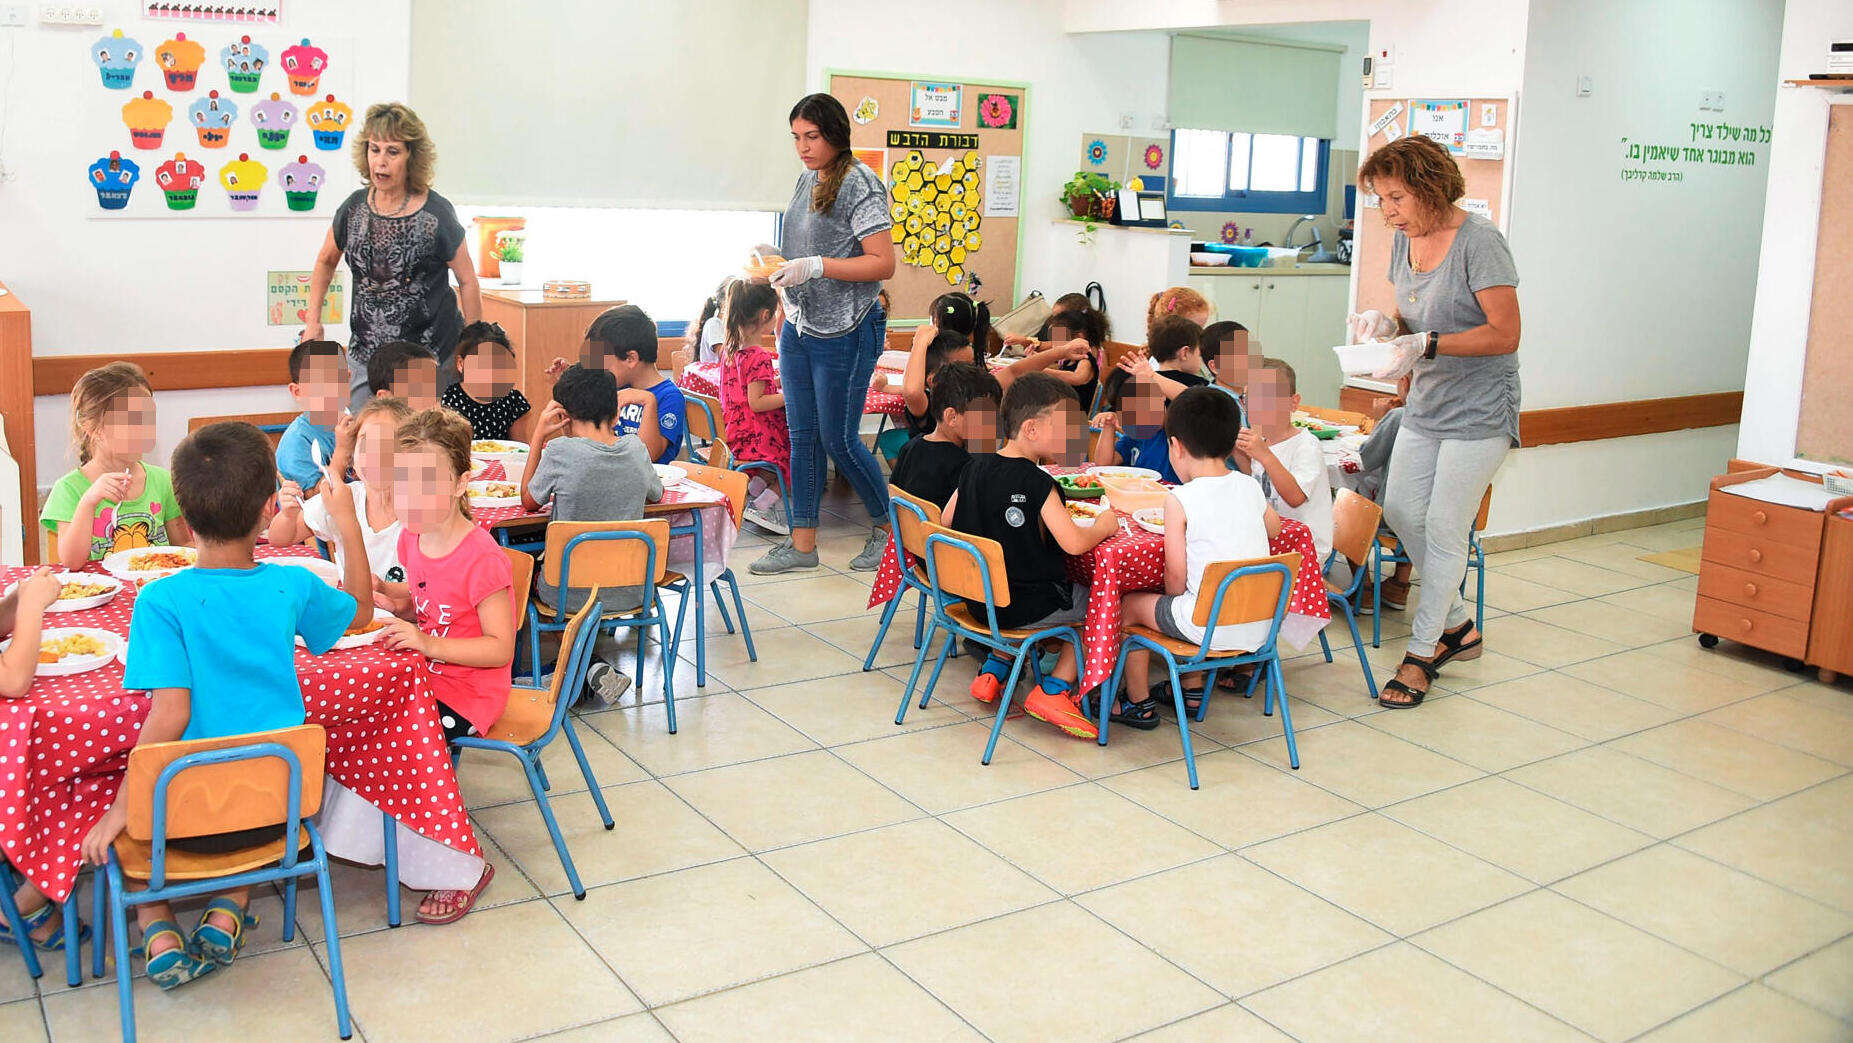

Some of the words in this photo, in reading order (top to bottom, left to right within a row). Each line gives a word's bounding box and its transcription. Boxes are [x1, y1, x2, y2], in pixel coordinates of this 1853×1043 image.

[890, 132, 929, 146] הדבש
[1690, 122, 1714, 142] צריך
[1717, 122, 1742, 142] שילד
[1743, 127, 1757, 142] מה
[939, 134, 979, 147] דבורת
[1642, 144, 1680, 164] שיאמין
[1683, 147, 1705, 163] אחד
[1707, 149, 1736, 165] מבוגר
[1738, 150, 1756, 166] הוא
[1648, 169, 1667, 181] שלמה
[271, 284, 298, 296] הקסם
